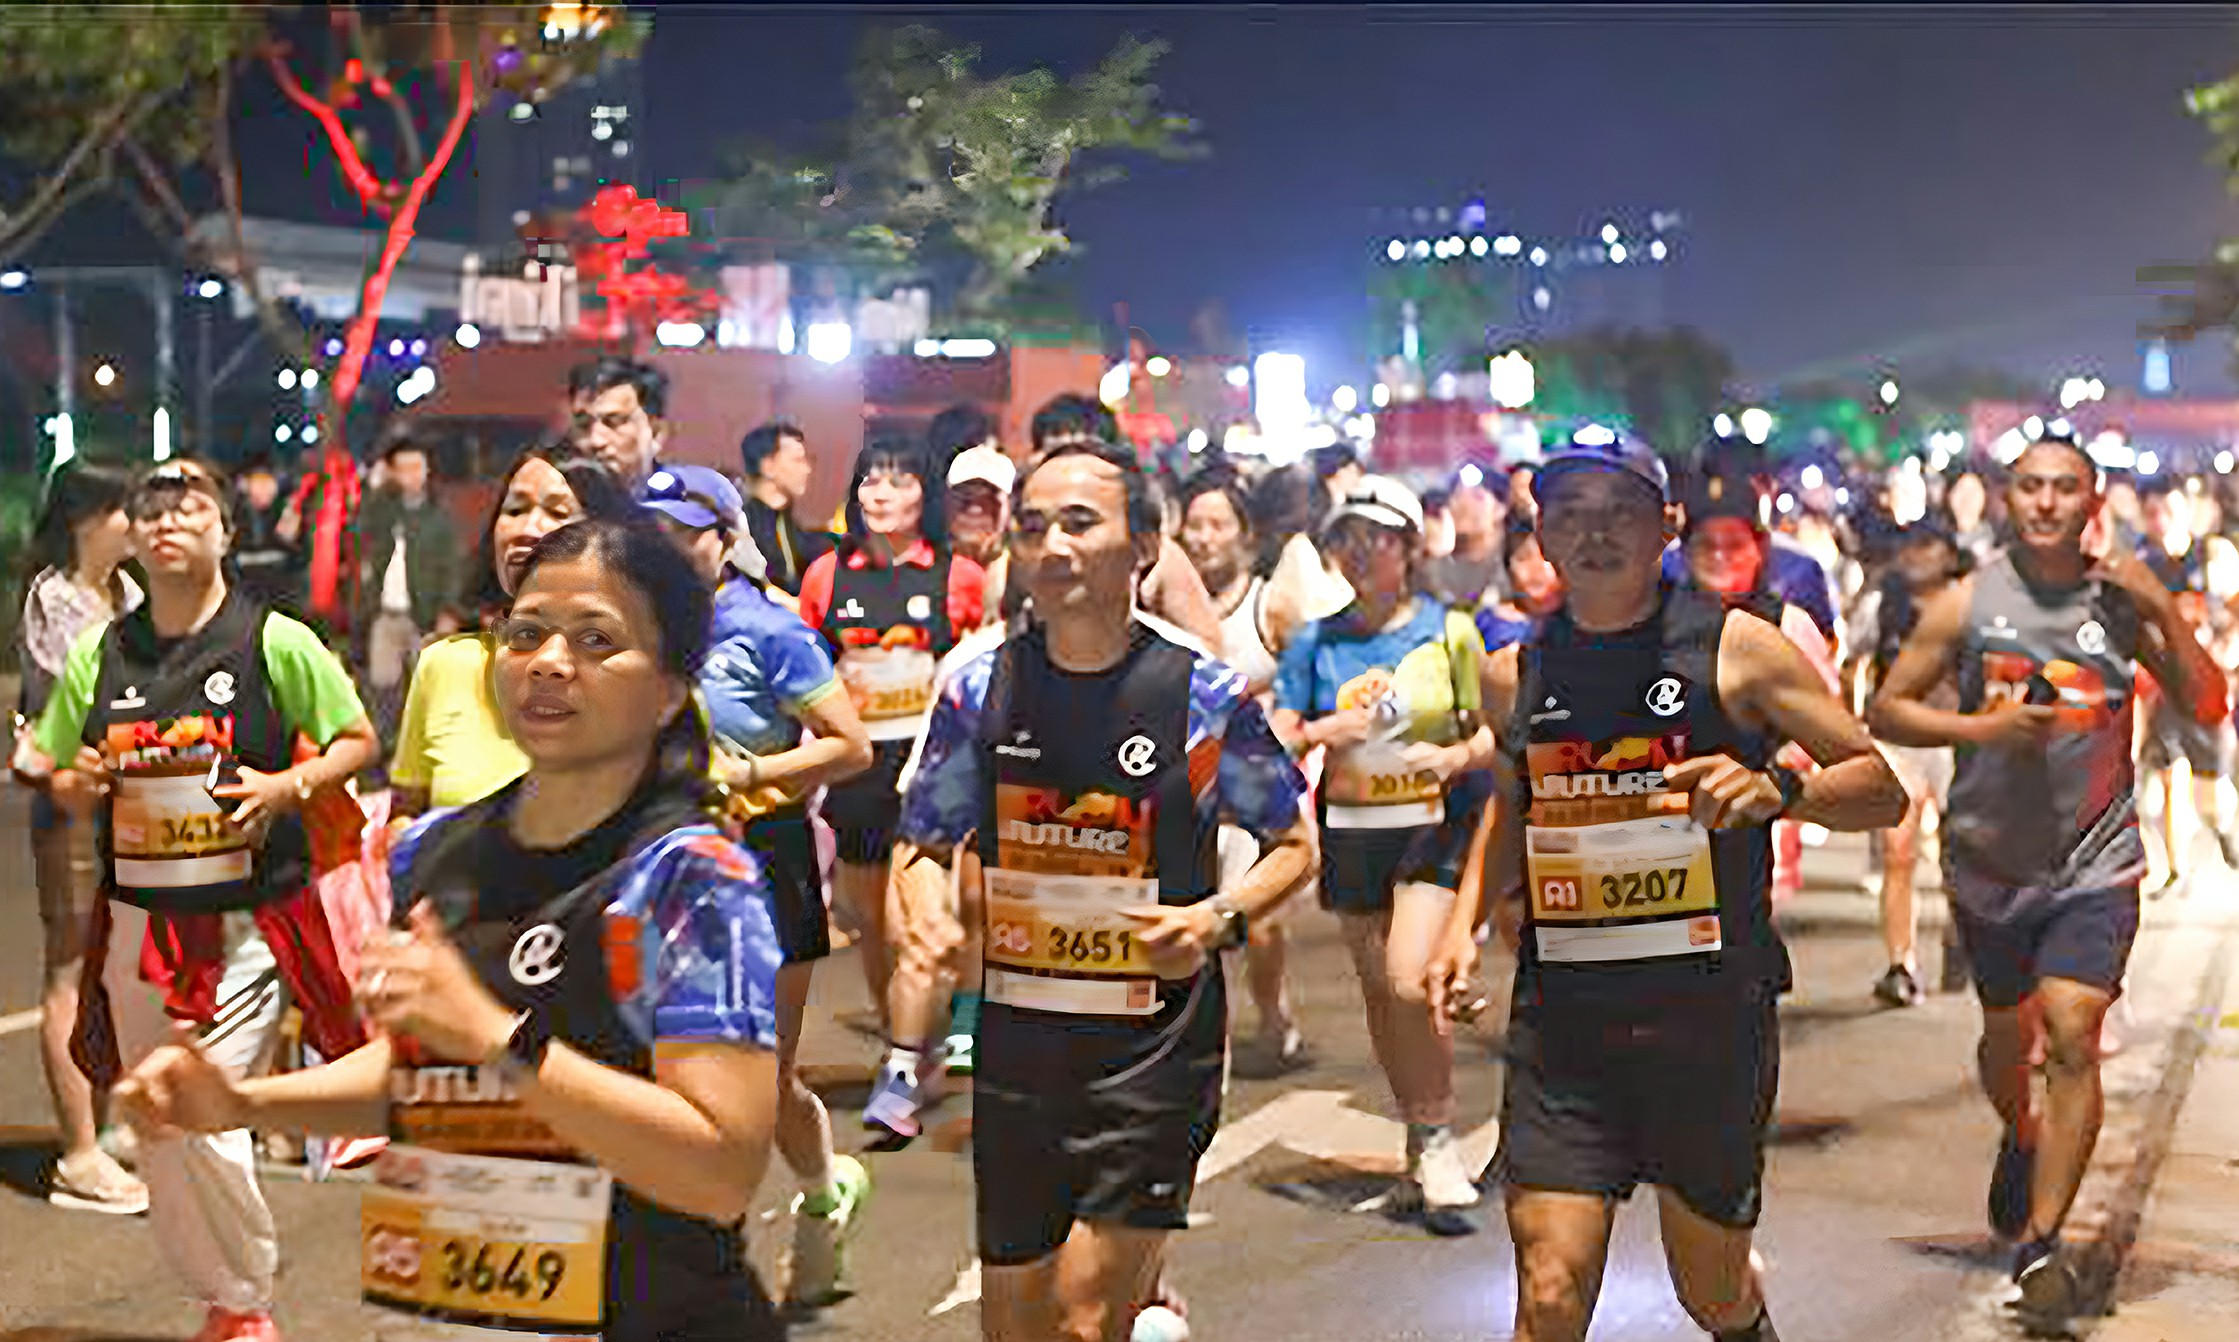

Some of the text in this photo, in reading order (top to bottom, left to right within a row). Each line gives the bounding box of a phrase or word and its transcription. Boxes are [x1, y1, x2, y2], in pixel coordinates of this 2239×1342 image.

[1601, 868, 1688, 908] 3207
[1049, 926, 1130, 962] 3651
[441, 1239, 566, 1301] 3649
